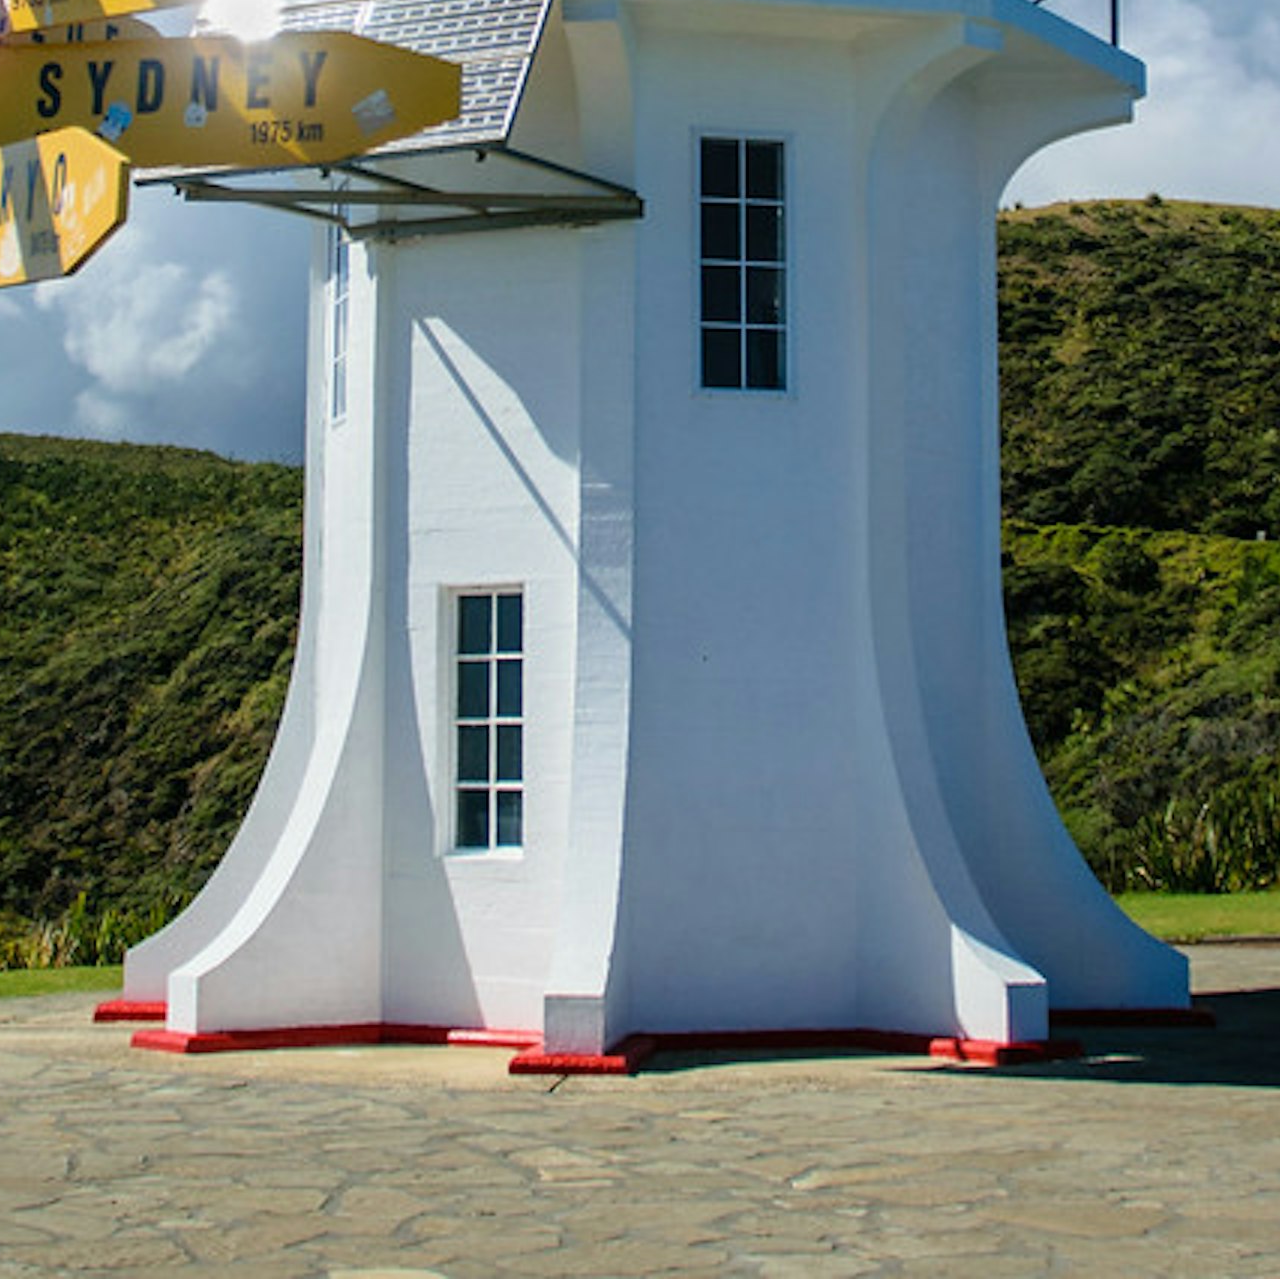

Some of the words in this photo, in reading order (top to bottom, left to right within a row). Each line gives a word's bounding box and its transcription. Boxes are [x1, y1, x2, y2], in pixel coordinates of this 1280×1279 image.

[36, 52, 327, 118] SYDNEY
[250, 120, 292, 144] 1975
[297, 119, 324, 143] km
